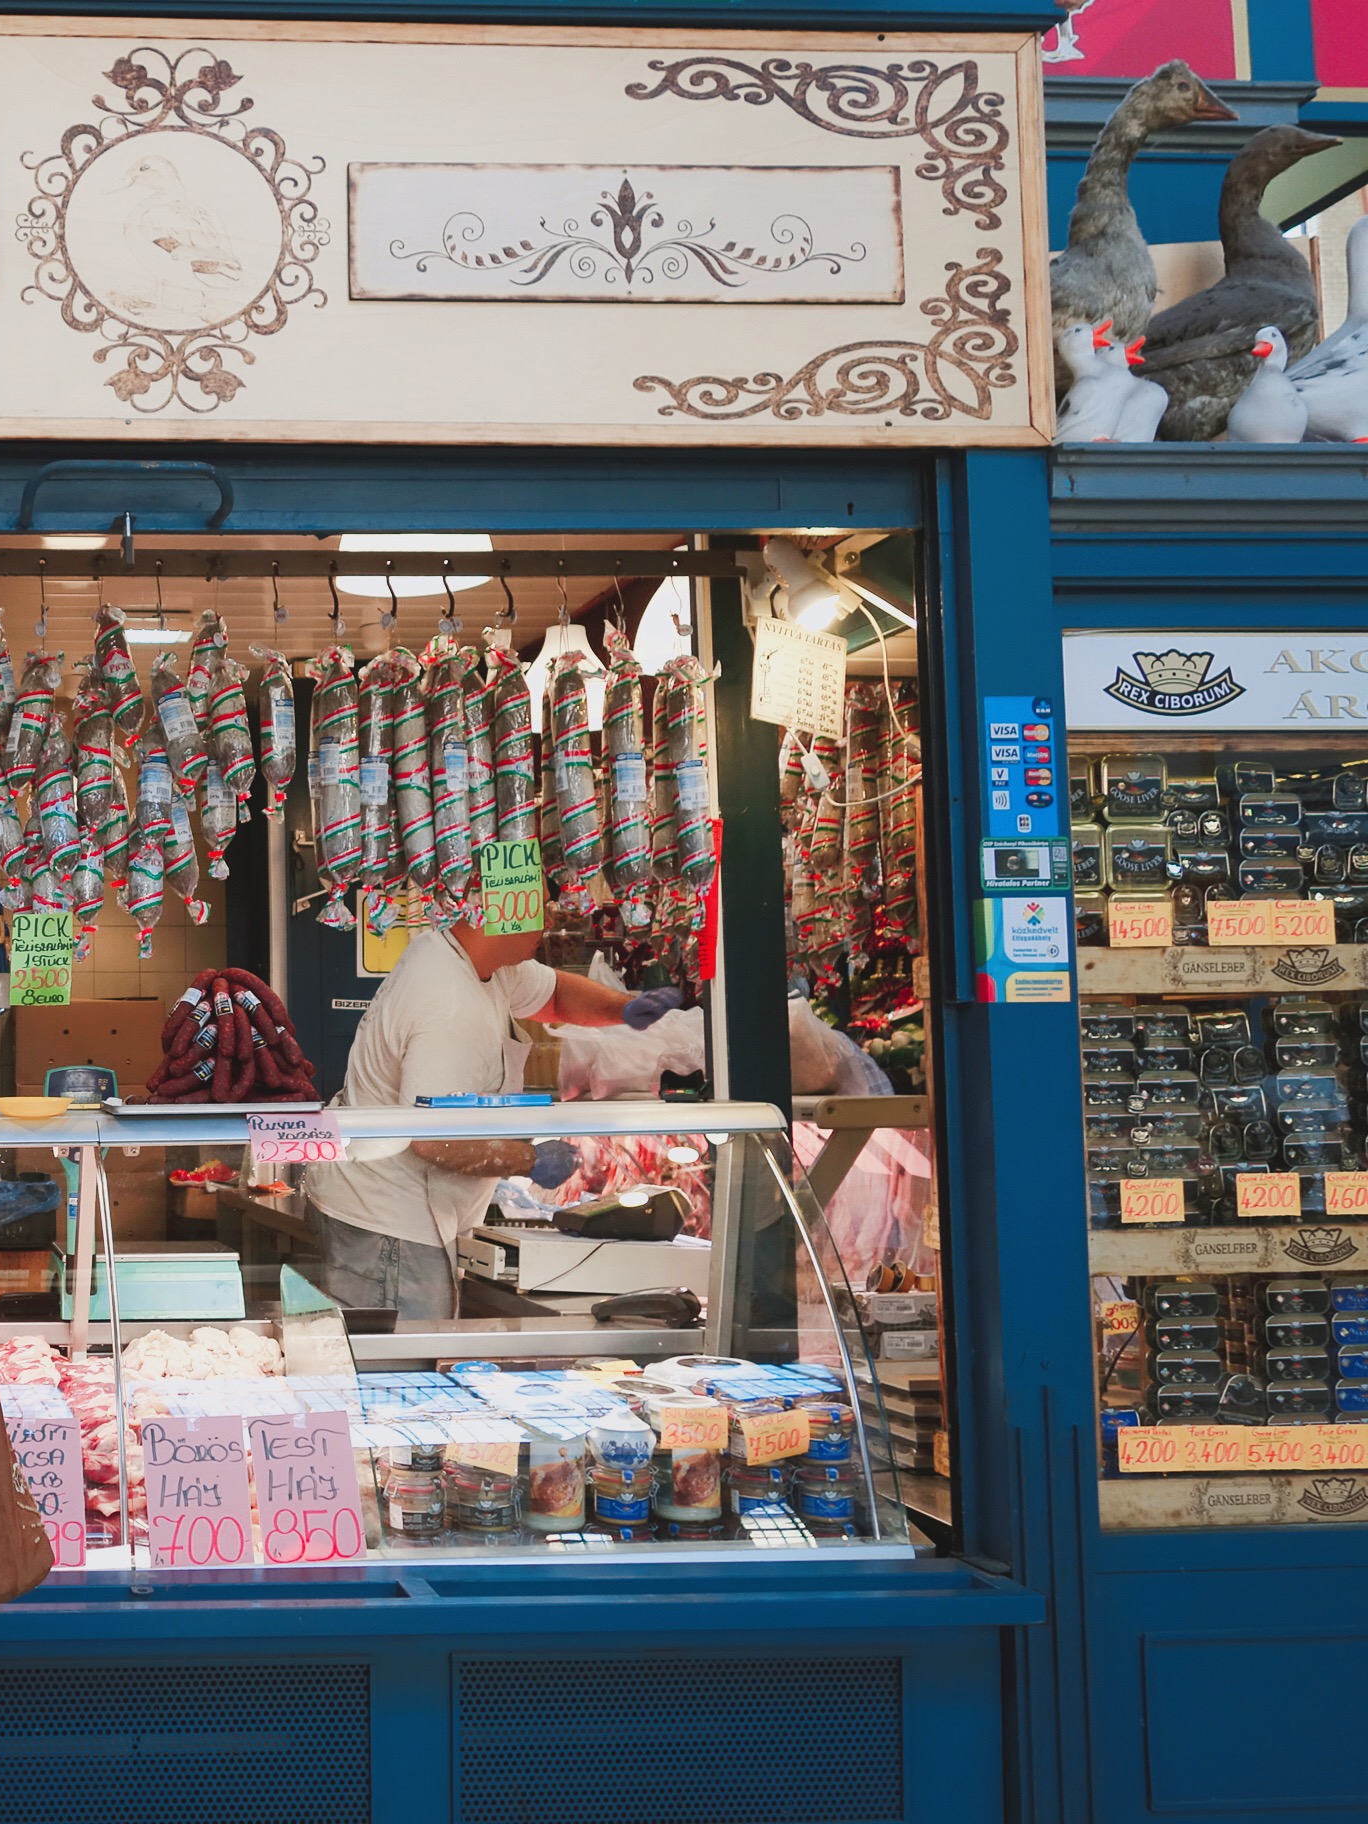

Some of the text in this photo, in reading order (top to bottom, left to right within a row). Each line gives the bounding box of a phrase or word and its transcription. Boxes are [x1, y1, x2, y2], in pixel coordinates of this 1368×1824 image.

[109, 662, 130, 673] PICK
[1118, 680, 1231, 709] REX CIBORUM
[1282, 689, 1368, 719] ÁR
[993, 726, 1017, 735] VISA
[994, 748, 1018, 758] VISA
[996, 770, 1004, 778] V
[1109, 786, 1135, 804] GOOSE
[1137, 787, 1159, 803] LIVER
[480, 842, 541, 871] PICK
[1114, 854, 1164, 871] GOOSE LIVER
[986, 879, 1050, 887] Hivatalos Partner
[13, 915, 70, 938] PICK
[1011, 926, 1059, 934] közkedvelt
[1297, 964, 1337, 981] CIBORUM
[248, 1419, 346, 1461] TEST
[159, 1474, 222, 1507] HÁJ
[268, 1465, 339, 1501] HÁJ
